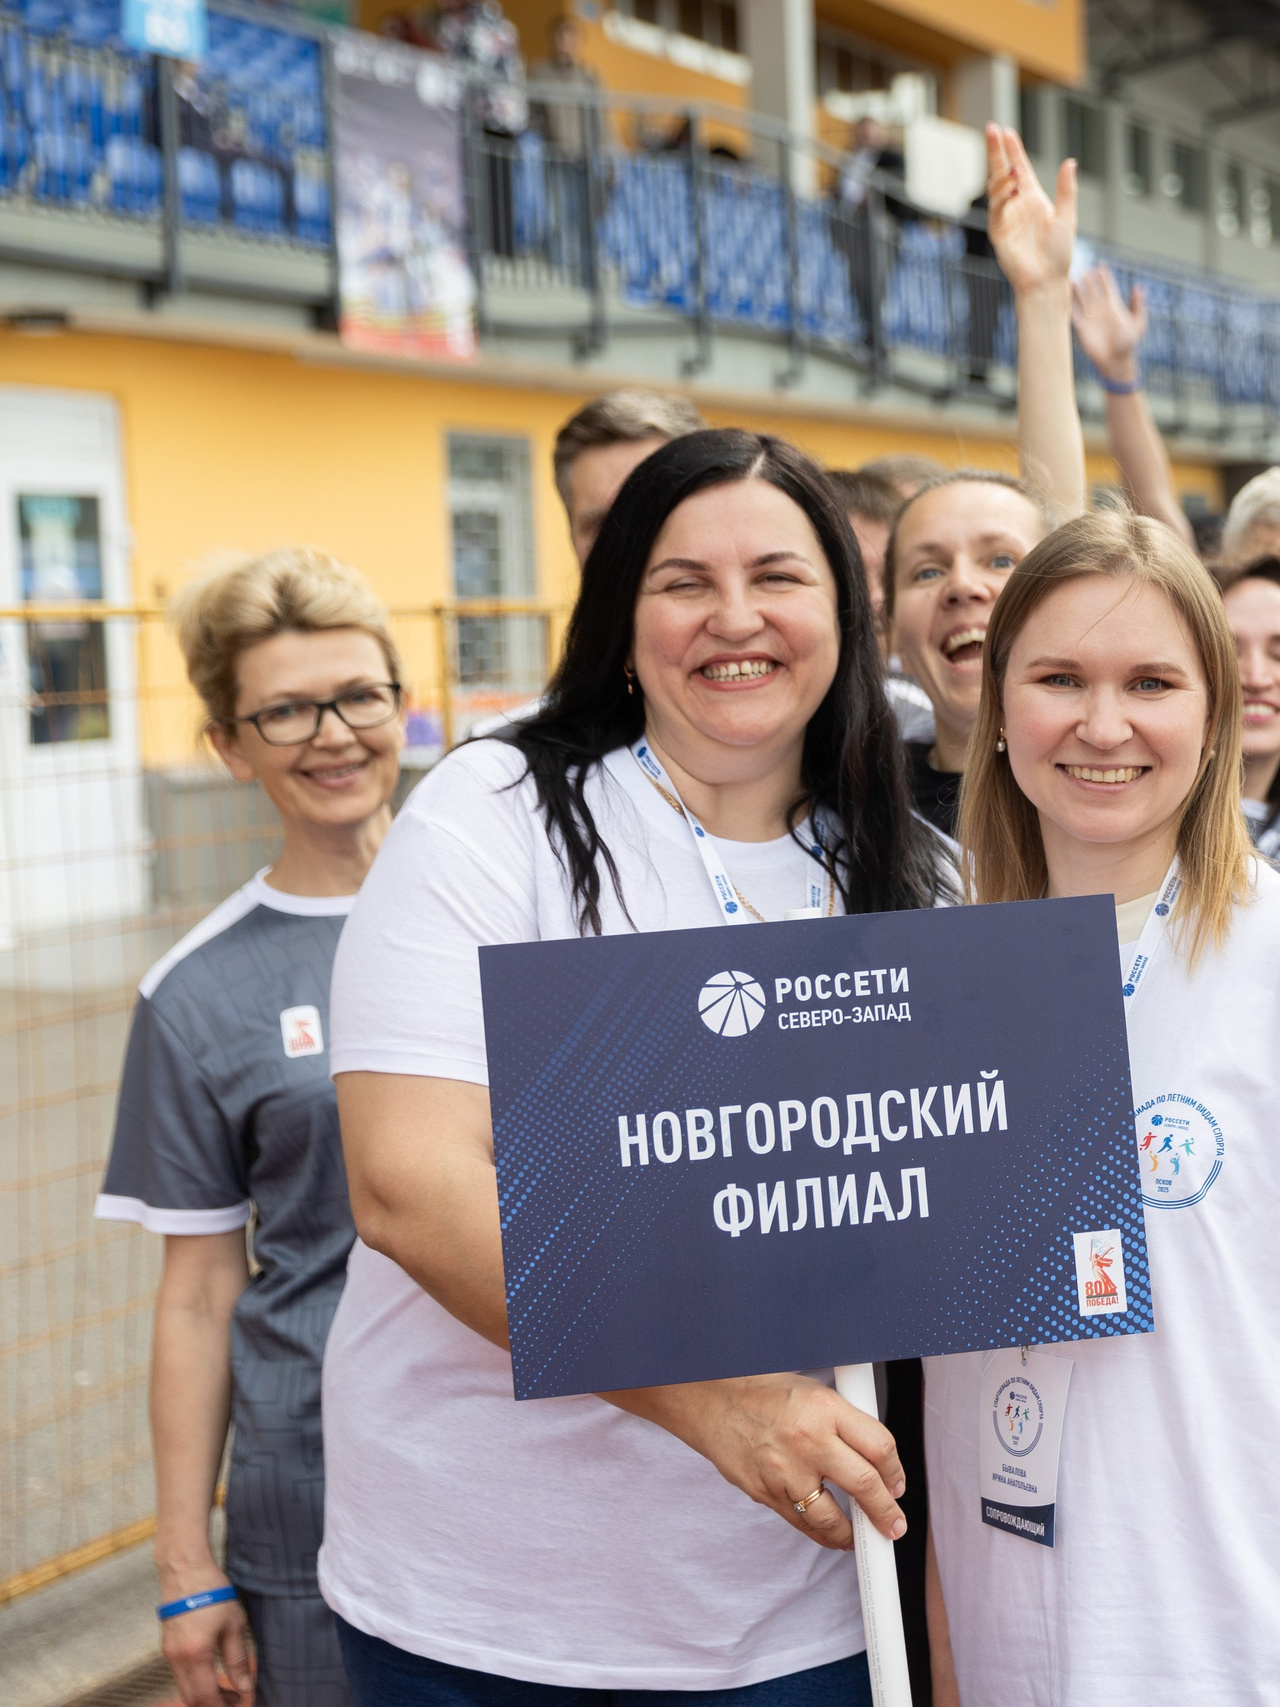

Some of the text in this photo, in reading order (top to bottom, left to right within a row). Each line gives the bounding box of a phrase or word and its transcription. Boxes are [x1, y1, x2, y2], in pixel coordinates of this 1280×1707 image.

[1128, 954, 1144, 982] РОССЕТИ
[775, 967, 909, 1003] РОССЕТИ
[778, 1002, 912, 1030] СЕВЕРО-ЗАПАД
[617, 1069, 1008, 1167] НОВГОРОДСКИЙ
[1156, 1094, 1166, 1104] ПО
[1166, 1093, 1198, 1108] ЛЕТНИМ
[1195, 1103, 1218, 1128] ВИДАМ
[1212, 1127, 1225, 1156] СПОРТА
[1164, 1116, 1190, 1126] РОССЕТИ
[713, 1167, 930, 1238] ФИЛИАЛ
[1085, 1281, 1103, 1297] 80
[1086, 1296, 1119, 1307] ПОБЕДА!
[985, 1505, 1046, 1537] СОПРОВОЖДАЮЩИЙ
